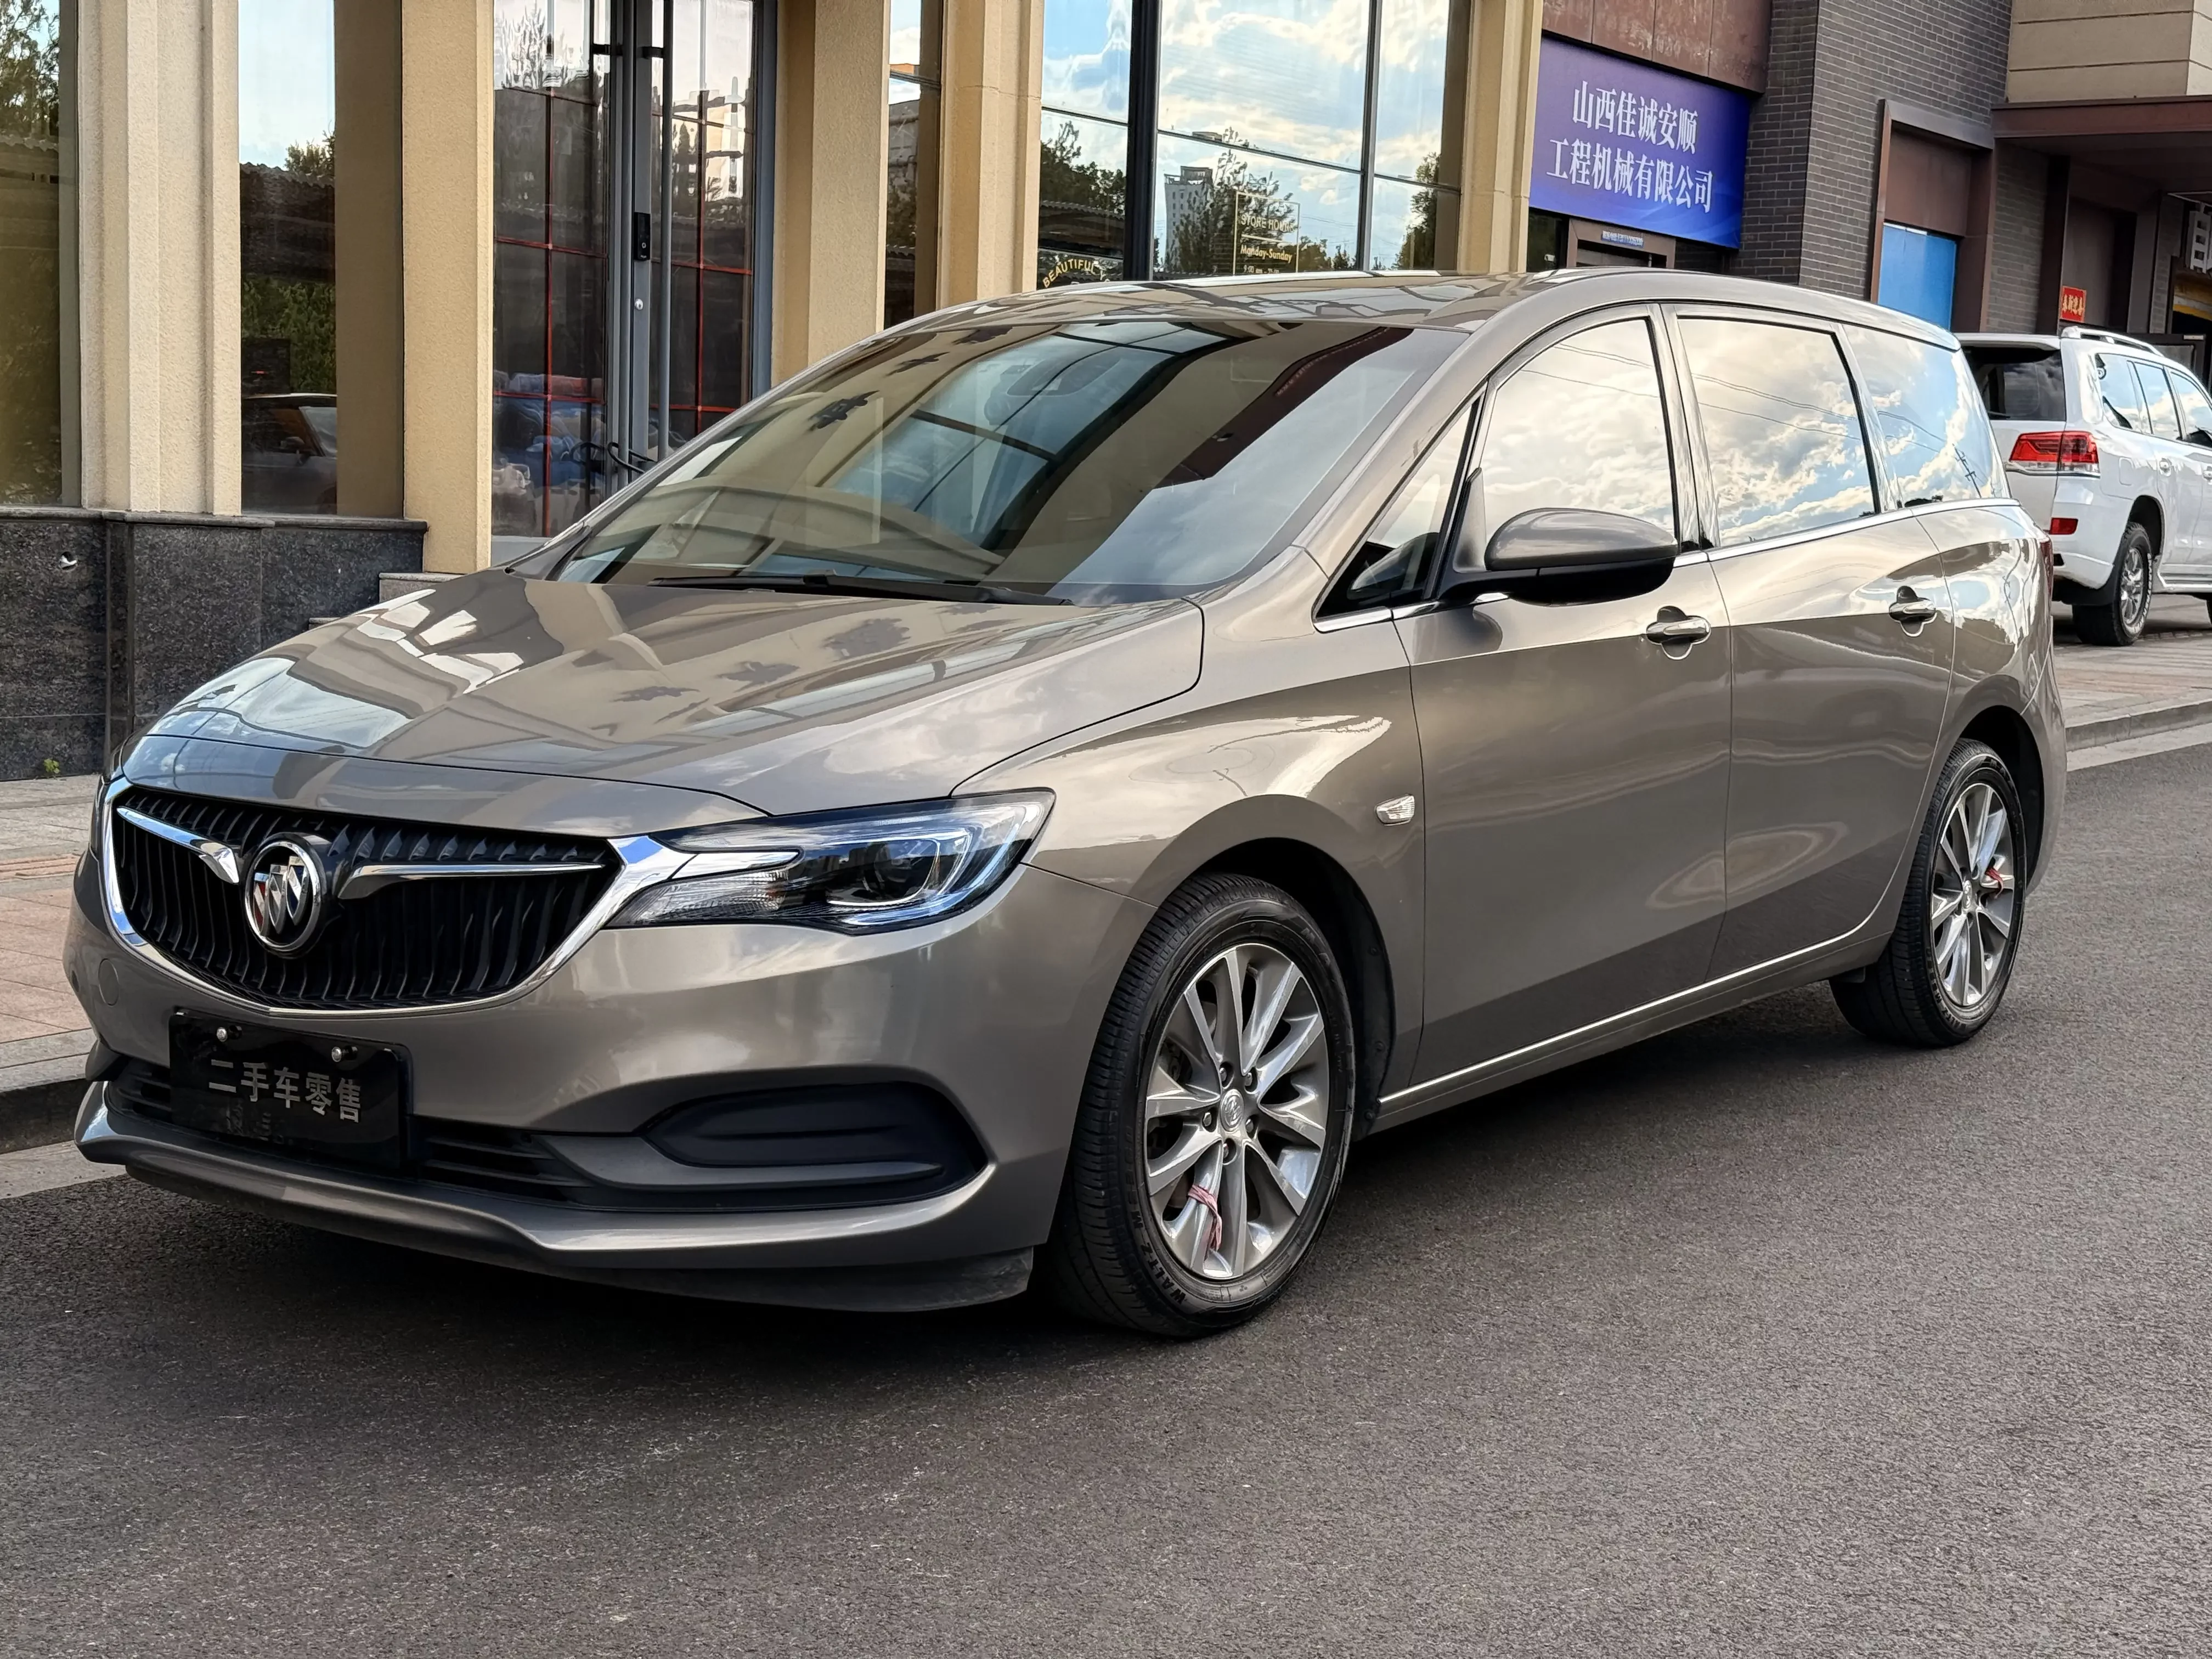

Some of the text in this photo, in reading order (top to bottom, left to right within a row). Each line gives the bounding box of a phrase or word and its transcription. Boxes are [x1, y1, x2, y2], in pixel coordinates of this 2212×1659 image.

[1573, 81, 1699, 154] 山西佳诚安顺
[1546, 138, 1713, 213] 工程机械有限公司
[1241, 215, 1267, 228] STORE
[1042, 258, 1096, 288] BEAUTIFUL
[208, 1059, 362, 1122] 二手车零售
[1141, 1242, 1187, 1305] WALTZ
